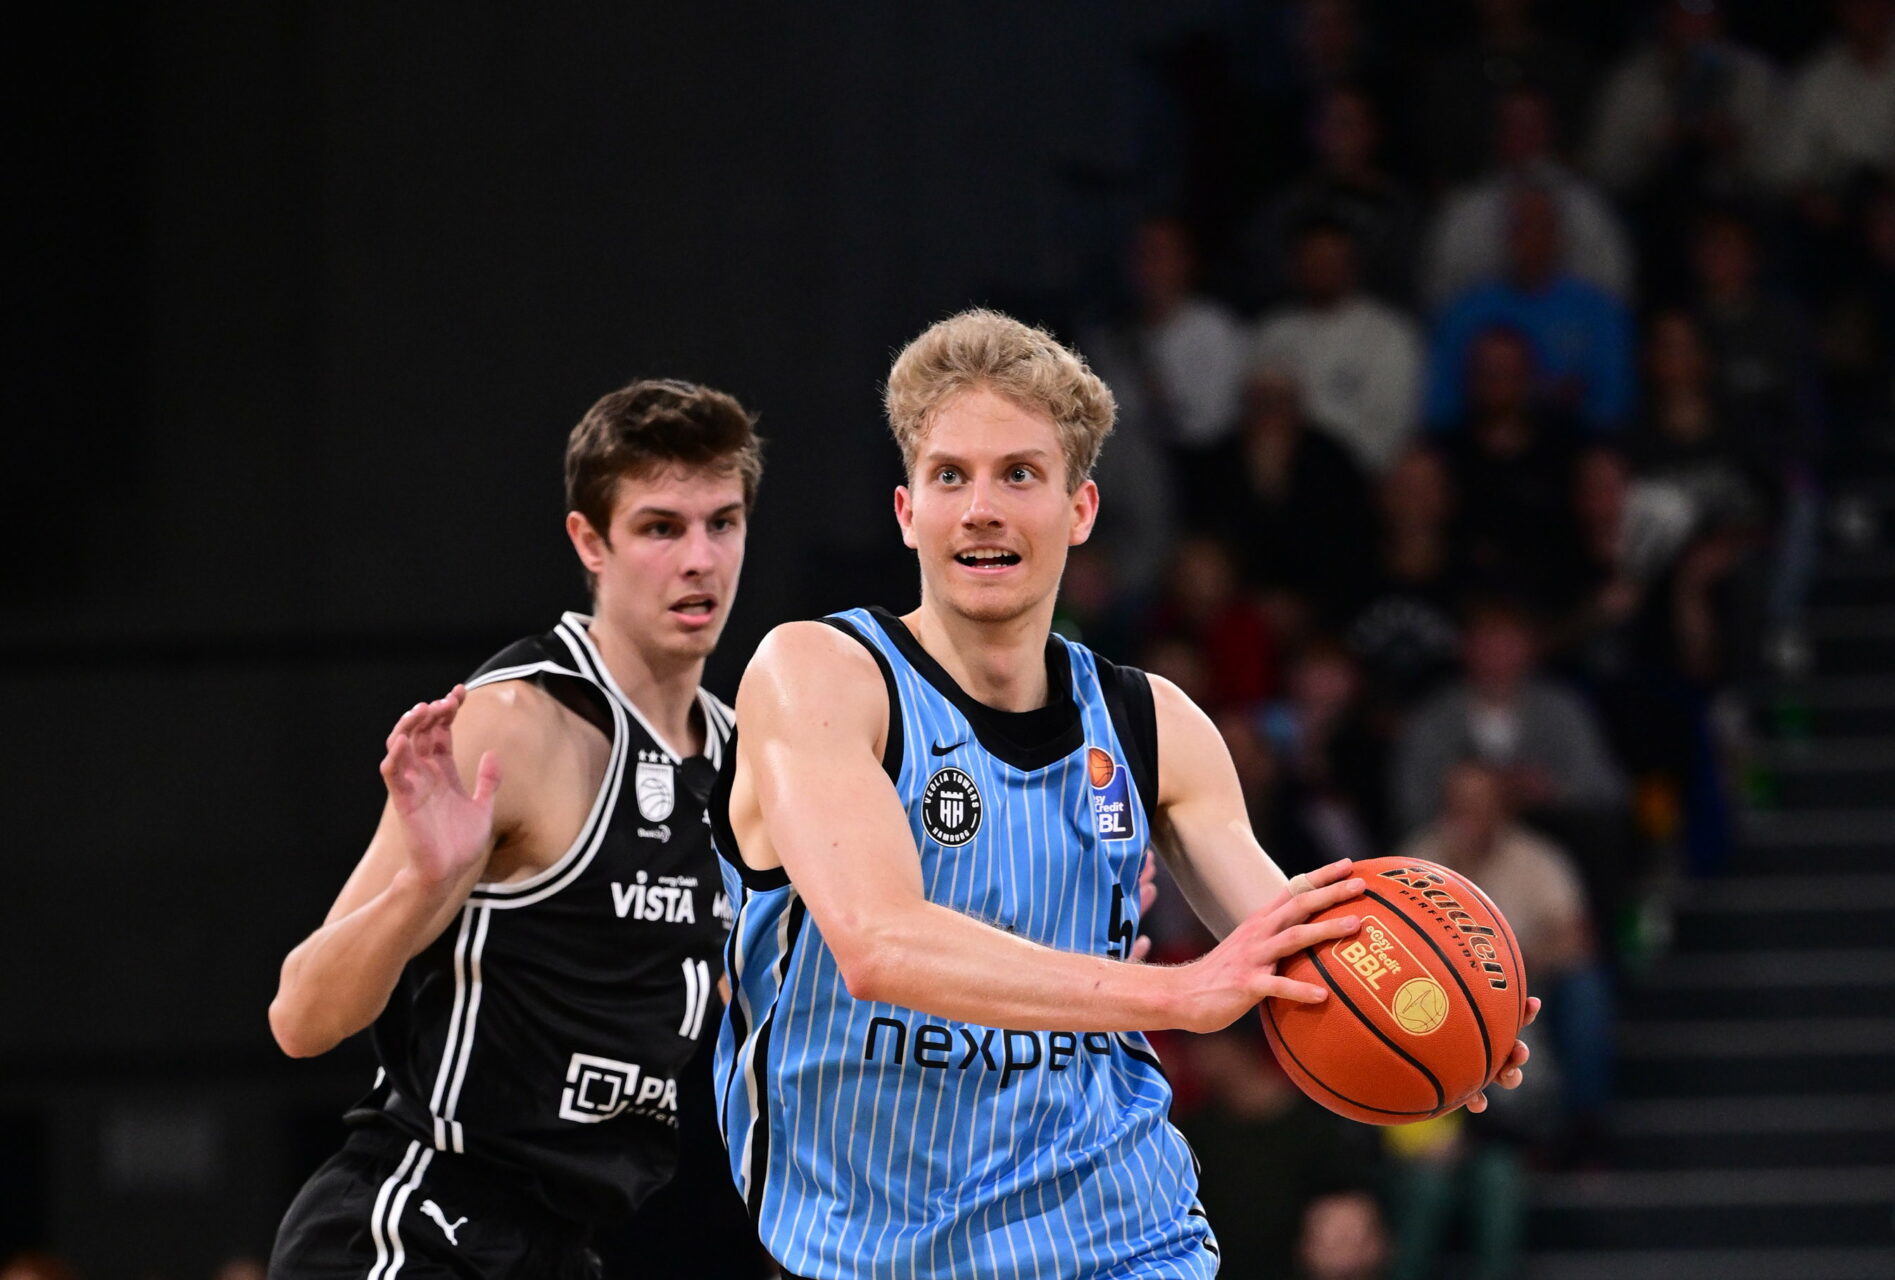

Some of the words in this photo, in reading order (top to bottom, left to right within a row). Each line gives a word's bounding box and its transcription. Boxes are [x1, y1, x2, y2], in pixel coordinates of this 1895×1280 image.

[924, 772, 949, 804] VEOLIA
[952, 772, 980, 808] TOWERS
[931, 826, 970, 842] HAMBURG
[1096, 812, 1127, 833] BL
[1377, 866, 1508, 991] Baden
[1399, 889, 1478, 972] PERFECTION
[1340, 941, 1388, 991] BBL
[1369, 942, 1402, 975] Credit
